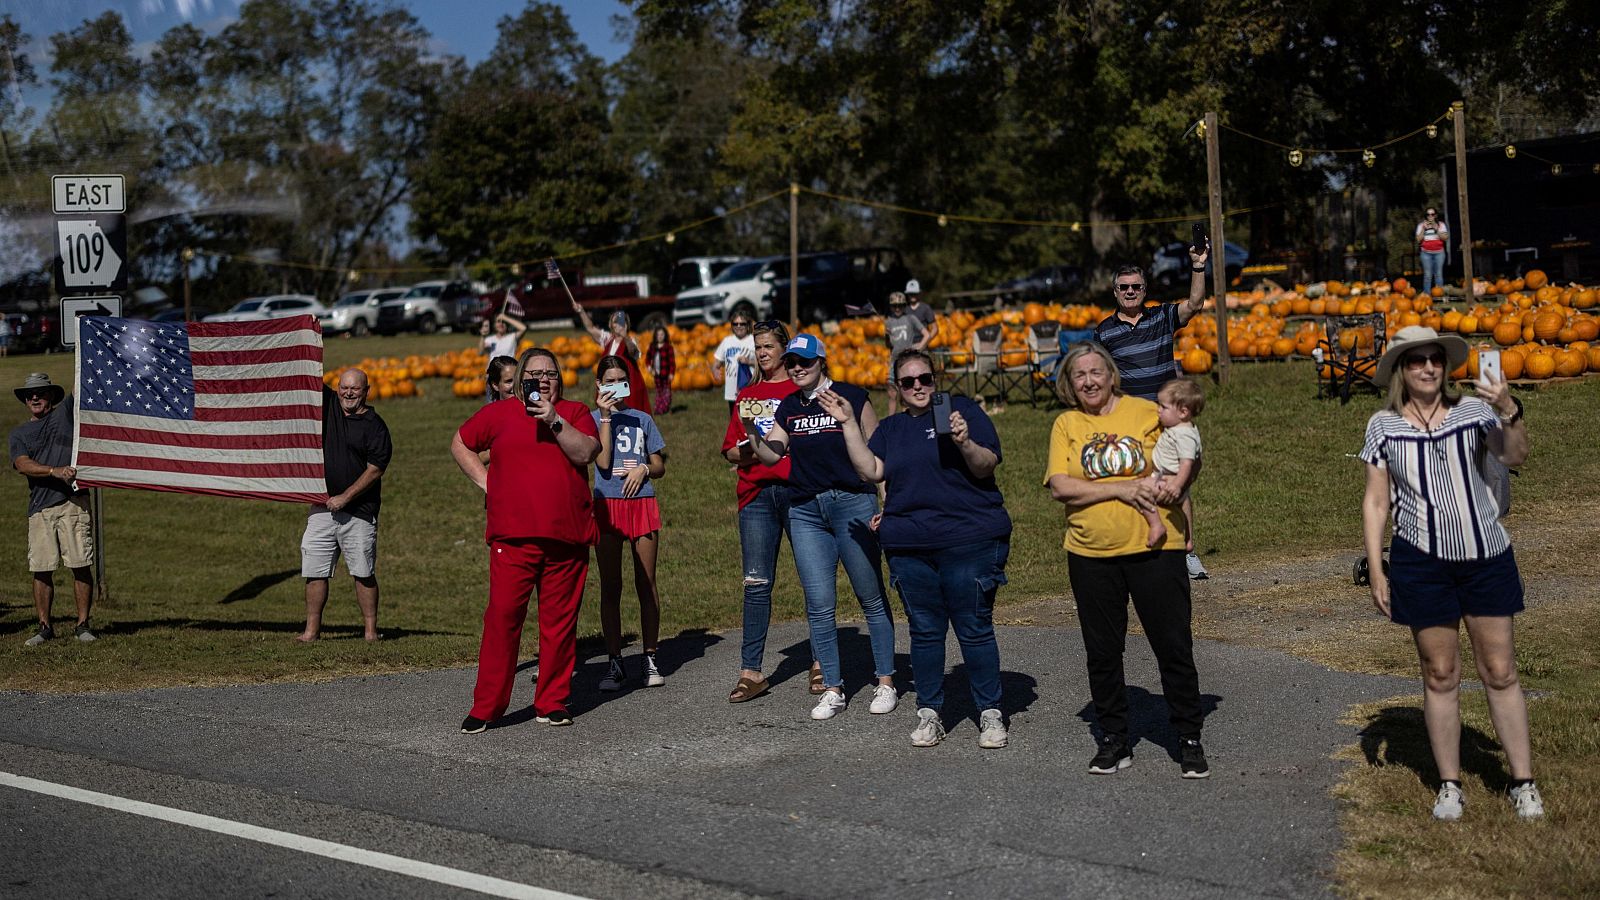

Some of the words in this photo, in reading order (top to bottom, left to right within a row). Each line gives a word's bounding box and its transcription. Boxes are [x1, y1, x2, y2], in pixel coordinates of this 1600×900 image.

[66, 183, 112, 205] EAST
[66, 234, 104, 274] 109
[616, 427, 645, 457] SA
